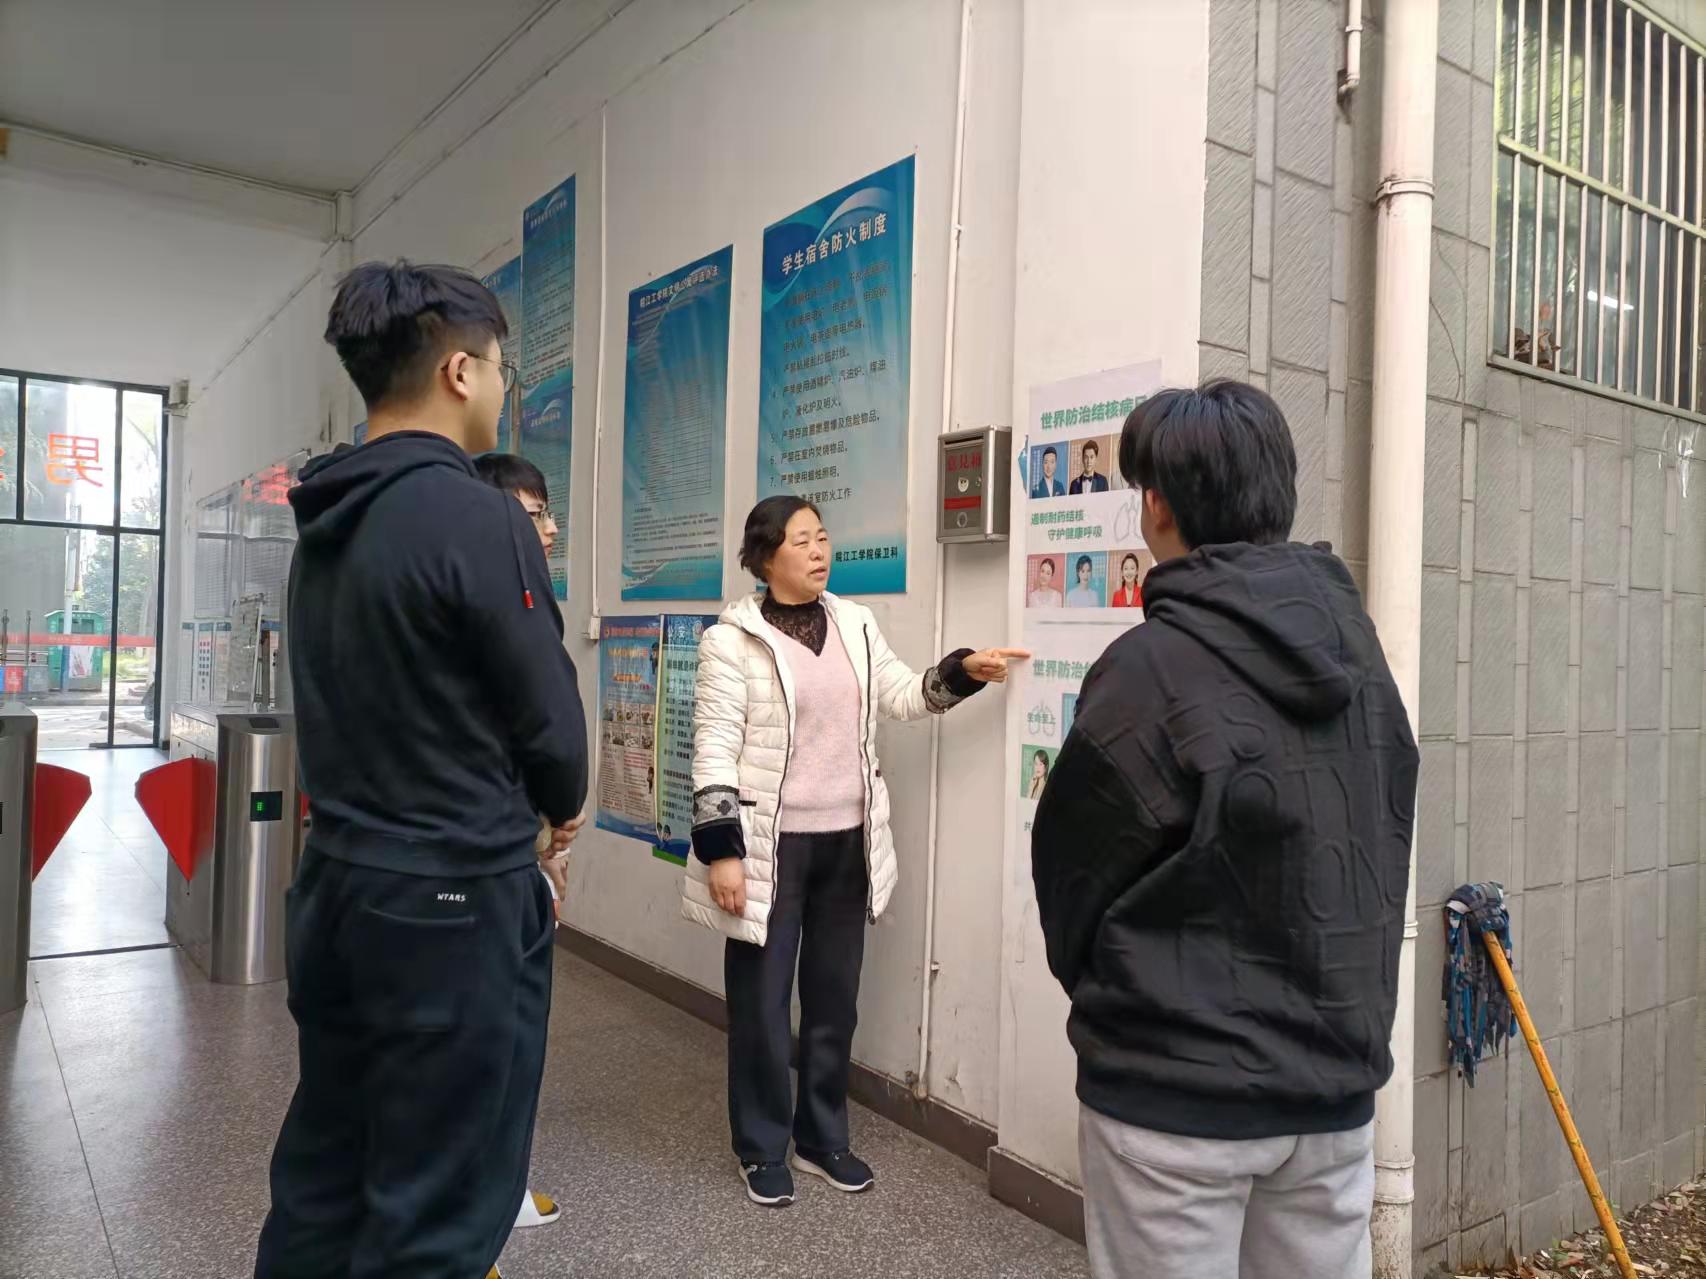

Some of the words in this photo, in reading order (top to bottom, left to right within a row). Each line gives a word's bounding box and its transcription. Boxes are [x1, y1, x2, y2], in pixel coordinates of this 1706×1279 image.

[781, 213, 887, 275] 学生宿舍防火制度
[1031, 510, 1084, 525] 遏制耐药结核
[1047, 526, 1102, 541] 守护健康呼吸
[835, 545, 898, 563] 皖江工学院保卫科
[1027, 711, 1056, 724] 生命至上
